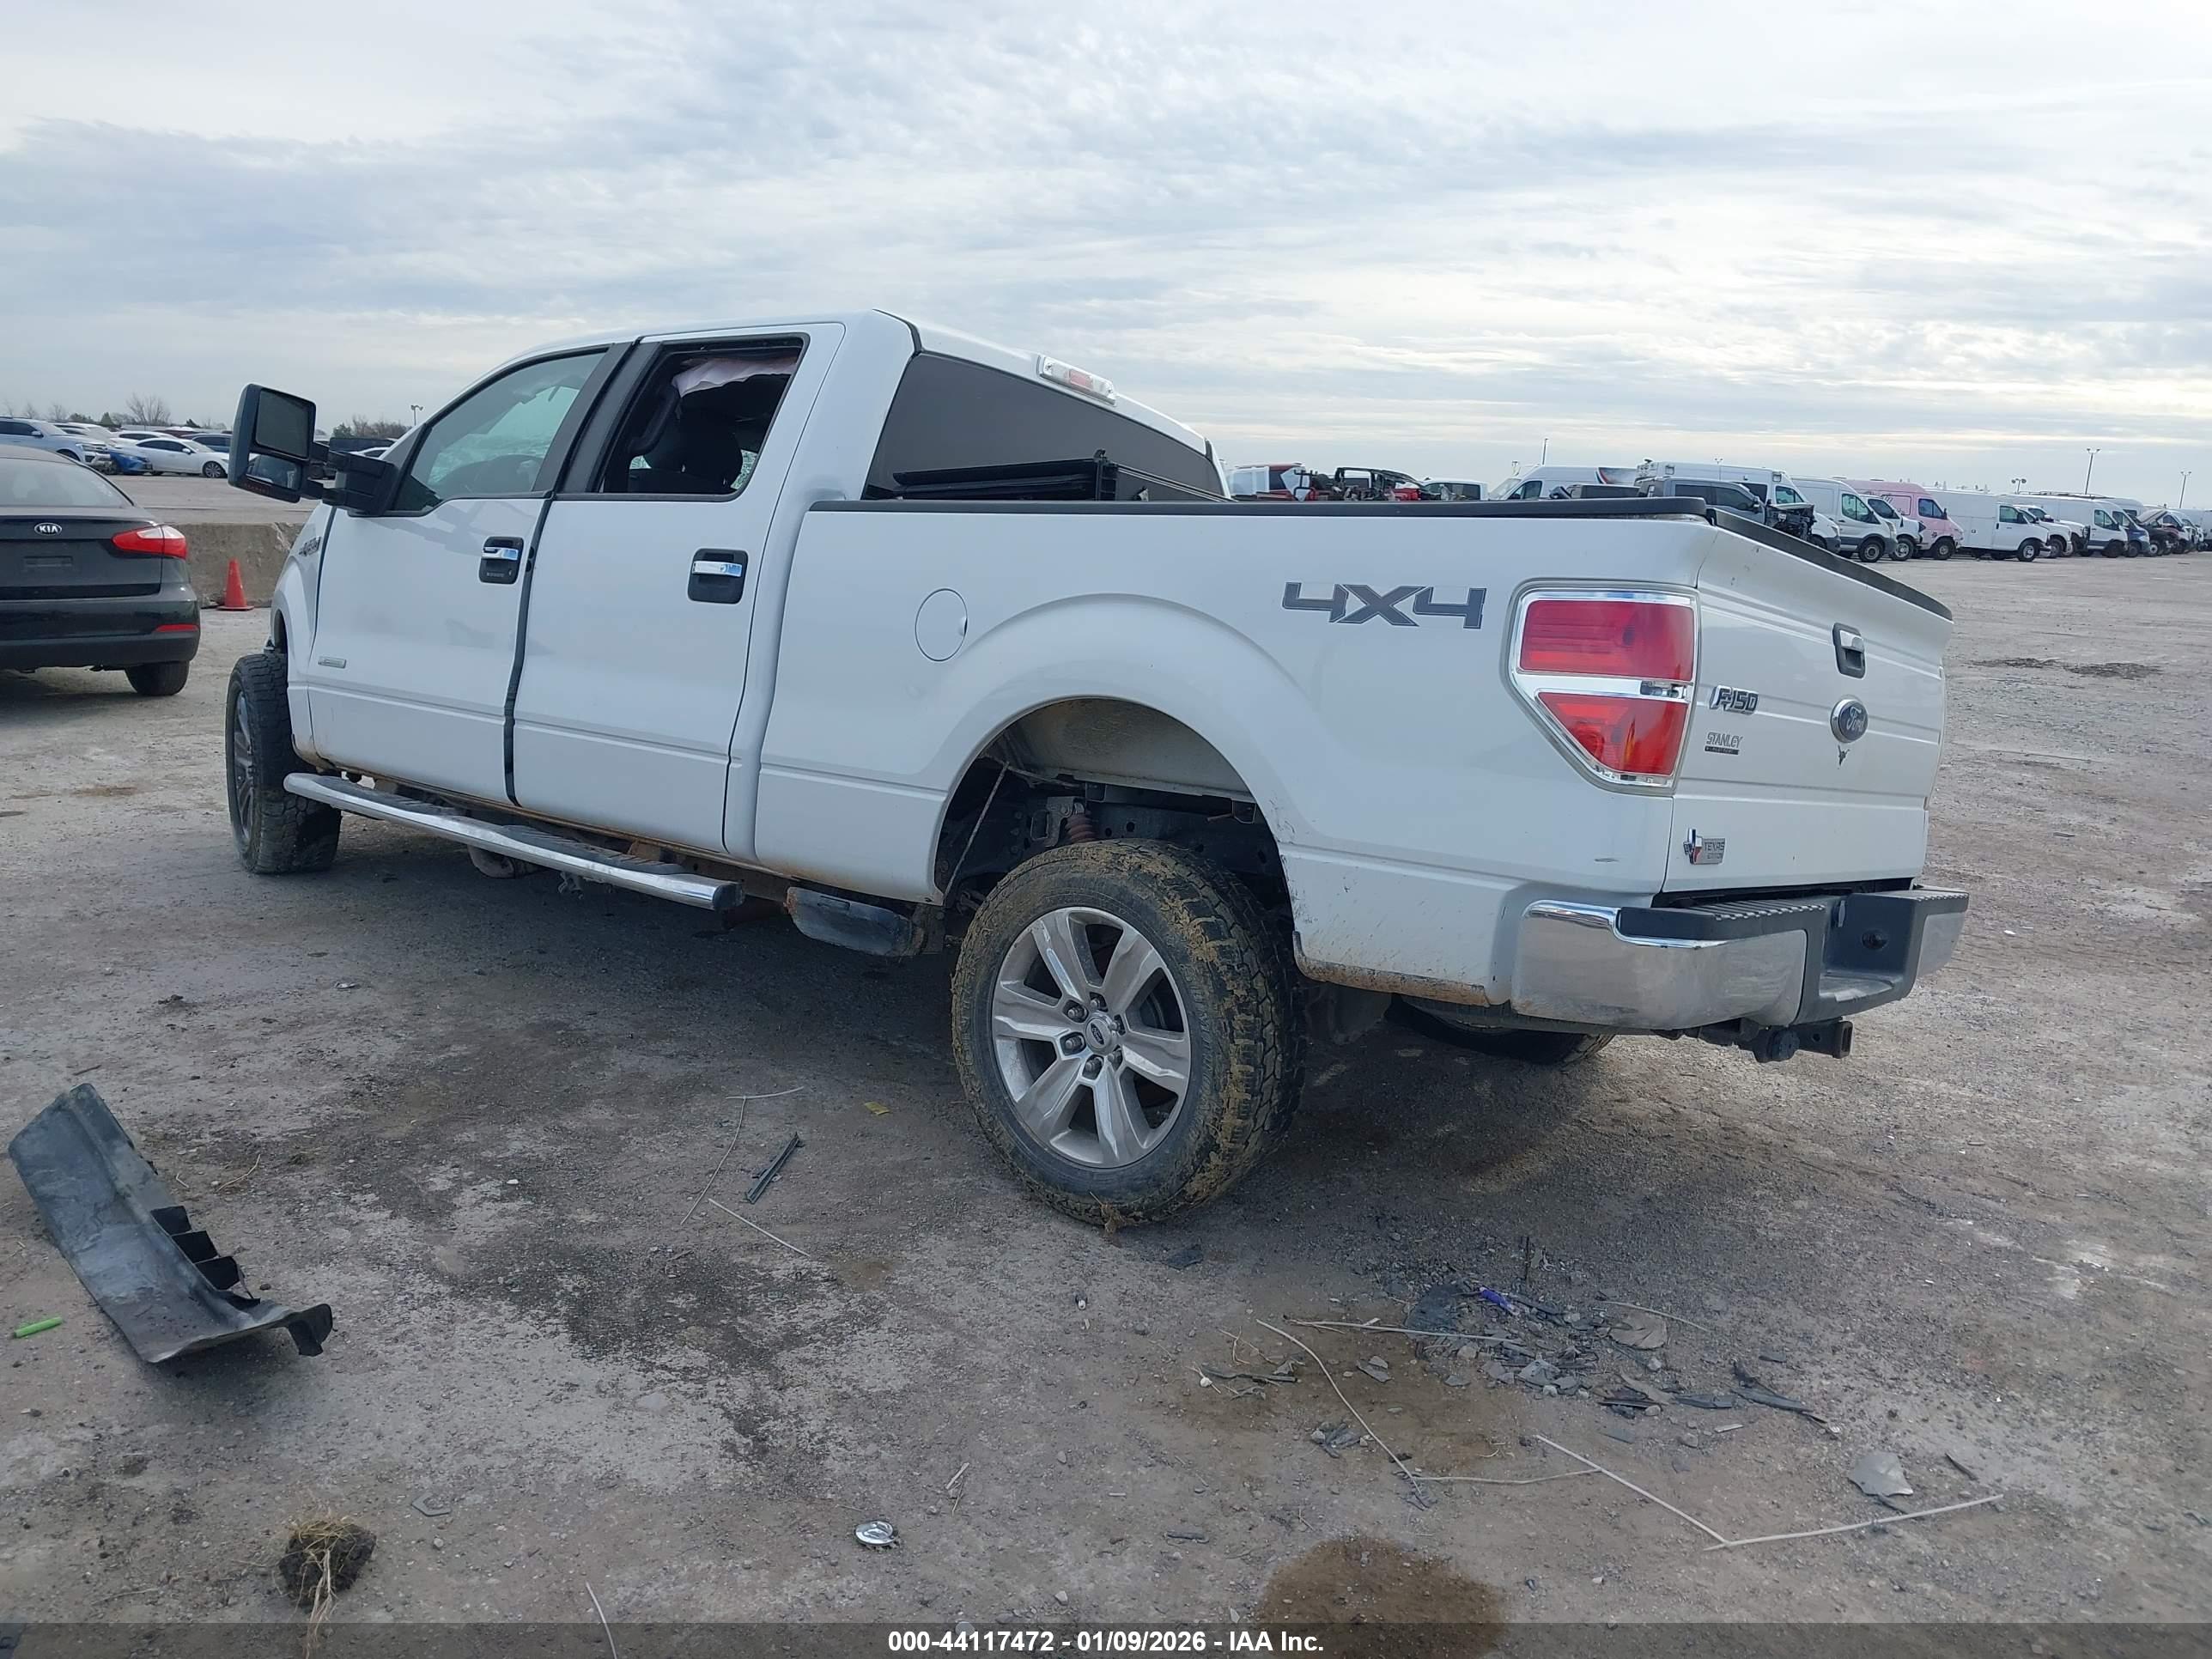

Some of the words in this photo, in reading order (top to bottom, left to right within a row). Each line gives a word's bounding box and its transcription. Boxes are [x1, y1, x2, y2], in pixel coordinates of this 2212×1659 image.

[38, 525, 59, 534] KIA
[1711, 685, 1759, 714] F-150
[1844, 706, 1865, 733] Ford
[1705, 732, 1744, 749] STANLEY
[1704, 842, 1725, 851] TEXAS
